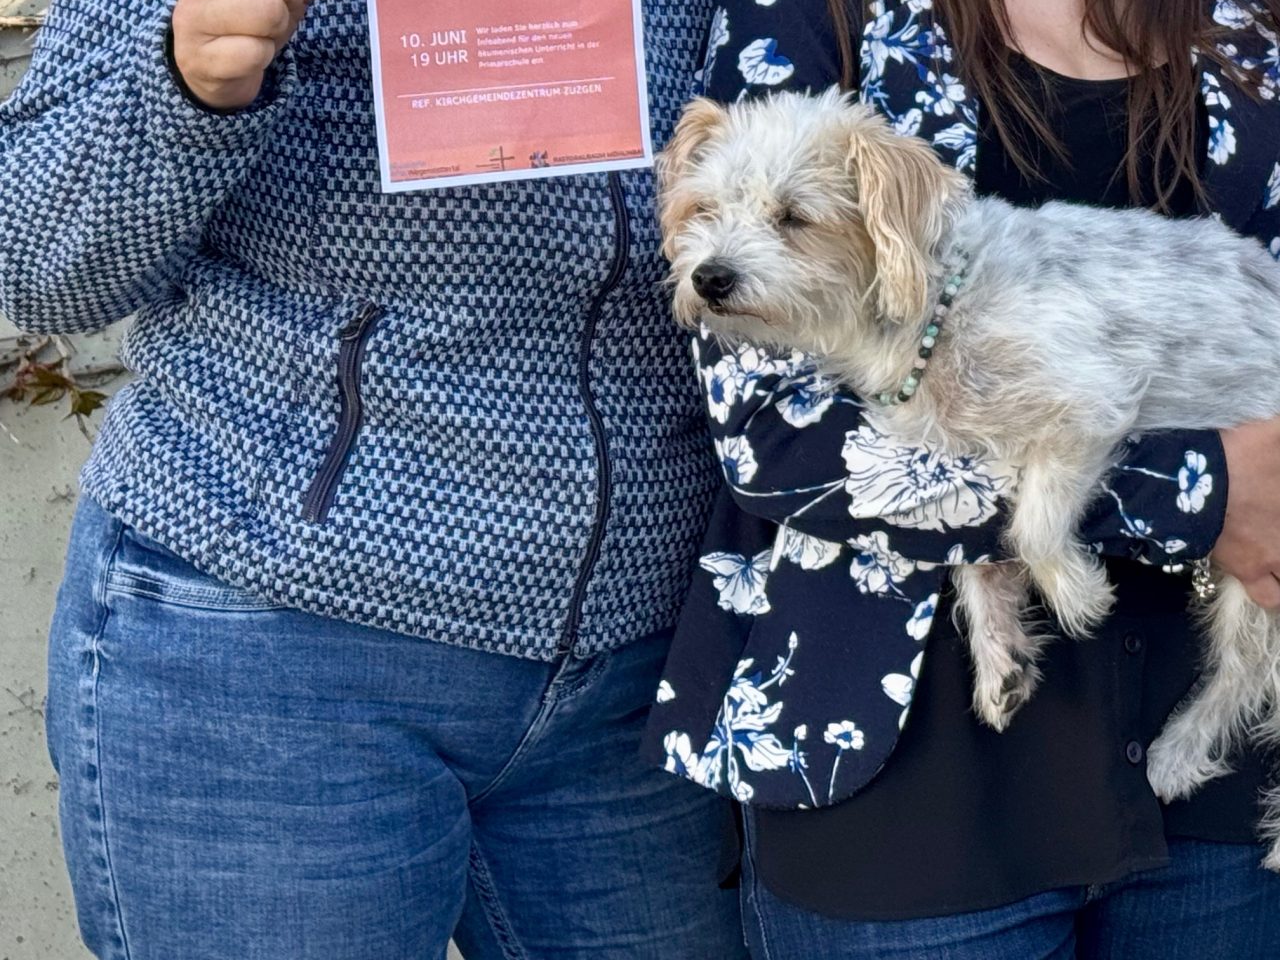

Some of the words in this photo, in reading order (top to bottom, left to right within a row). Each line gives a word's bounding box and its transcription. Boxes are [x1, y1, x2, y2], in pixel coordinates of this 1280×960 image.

[400, 33, 425, 48] 10.
[430, 30, 468, 47] JUNI
[410, 52, 430, 68] 19
[435, 49, 469, 66] UHR
[411, 97, 433, 110] REF.
[435, 87, 561, 107] KIRCHGEMEINDEZENTRUM
[564, 83, 603, 96] ZUZGEN
